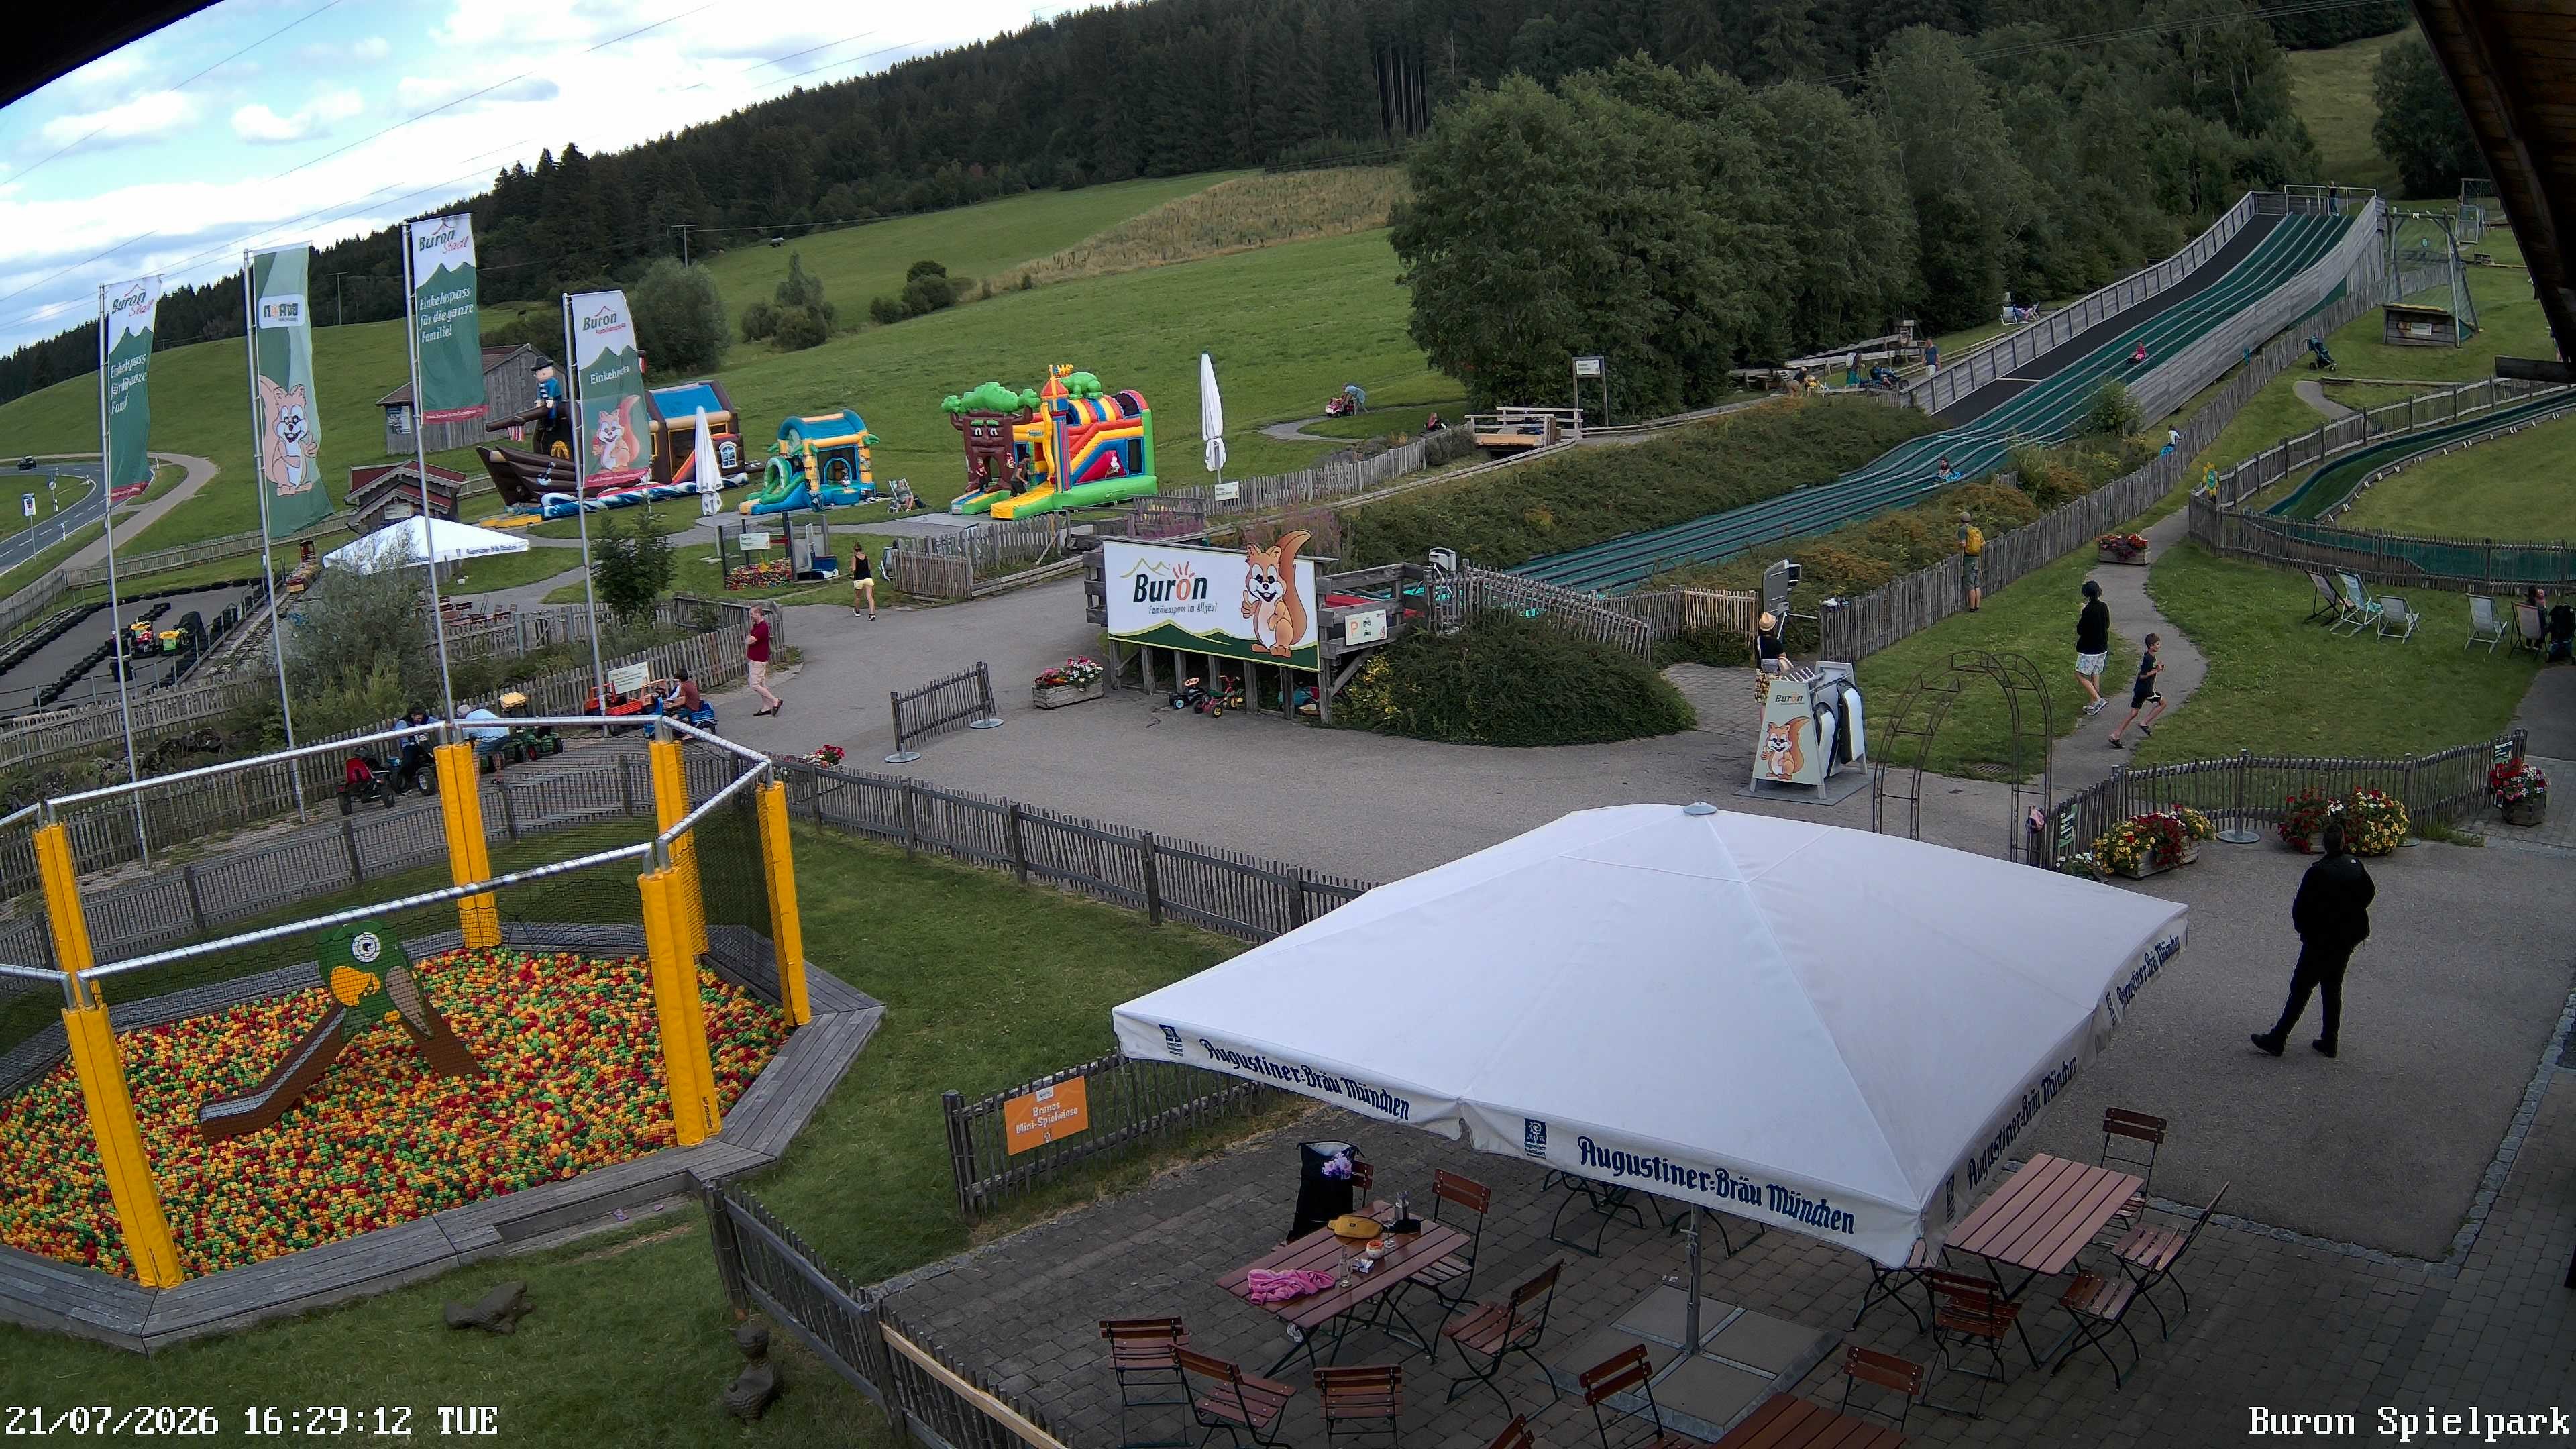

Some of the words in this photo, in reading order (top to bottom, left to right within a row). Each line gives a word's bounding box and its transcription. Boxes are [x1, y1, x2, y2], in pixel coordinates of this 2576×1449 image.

[419, 230, 455, 252] Buron
[111, 292, 146, 315] Buron
[433, 310, 447, 323] die
[582, 313, 617, 331] Buron
[1133, 573, 1208, 603] Buron
[1187, 604, 1195, 612] im
[1775, 694, 1803, 703] Buron
[1033, 1102, 1061, 1116] Brunos
[1341, 1077, 1409, 1120] München
[1016, 1107, 1078, 1134] Mini-Spielwiese
[1766, 1183, 1855, 1235] München
